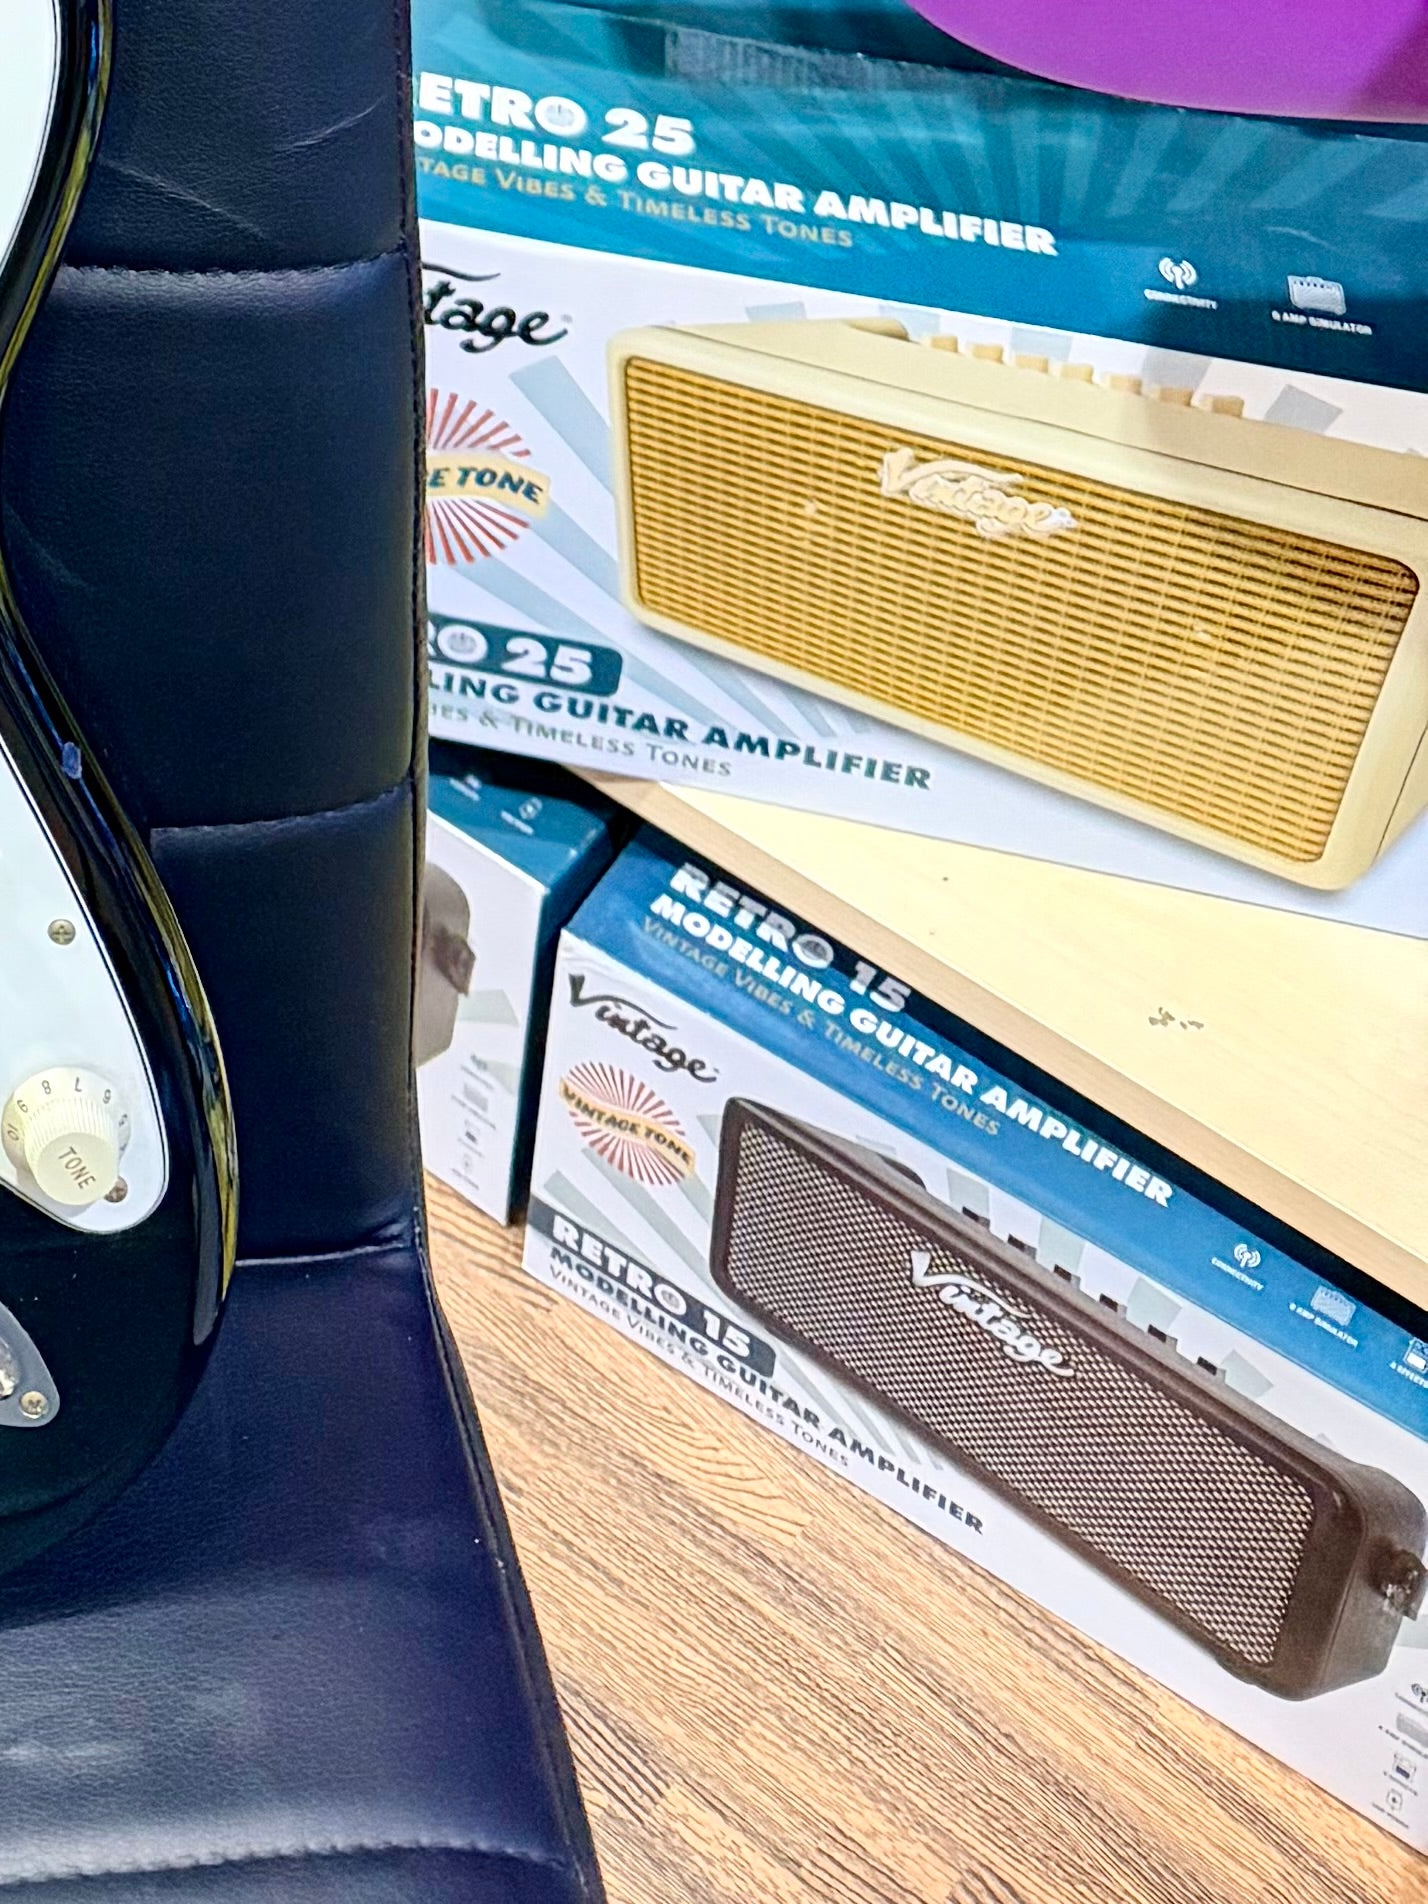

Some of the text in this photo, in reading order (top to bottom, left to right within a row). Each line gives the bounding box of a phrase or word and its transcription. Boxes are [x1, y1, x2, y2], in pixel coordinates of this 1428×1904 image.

[602, 107, 696, 156] 25
[497, 166, 855, 248] VIBES & TIMELESS TONES
[637, 153, 1059, 256] GUITAR AMPLIFIER
[457, 465, 545, 506] TONE
[505, 637, 594, 686] 25
[509, 715, 635, 757] TIMELESS
[645, 743, 733, 778] TONES
[533, 690, 933, 791] GUITAR AMPLIFIER
[669, 861, 913, 1014] RETRO 15
[568, 973, 719, 1083] Vintage
[644, 915, 1002, 1137] VINTAGE VIBES & TIMELESS TONES
[649, 893, 1174, 1209] MODELLING GUITAR AMPLIFIER
[42, 1080, 51, 1095] 8
[562, 1084, 692, 1166] VINTAGE TONE
[58, 1146, 97, 1189] TONE
[552, 1214, 752, 1360] RETRO 15
[910, 1250, 1075, 1379] Vintage
[547, 1262, 622, 1321] VINTAGE
[626, 1313, 676, 1357] VIBES
[702, 1363, 786, 1427] TIMELESS
[790, 1420, 851, 1468] TONES
[549, 1247, 985, 1536] MODELLING GUITAR AMPLIFIER
